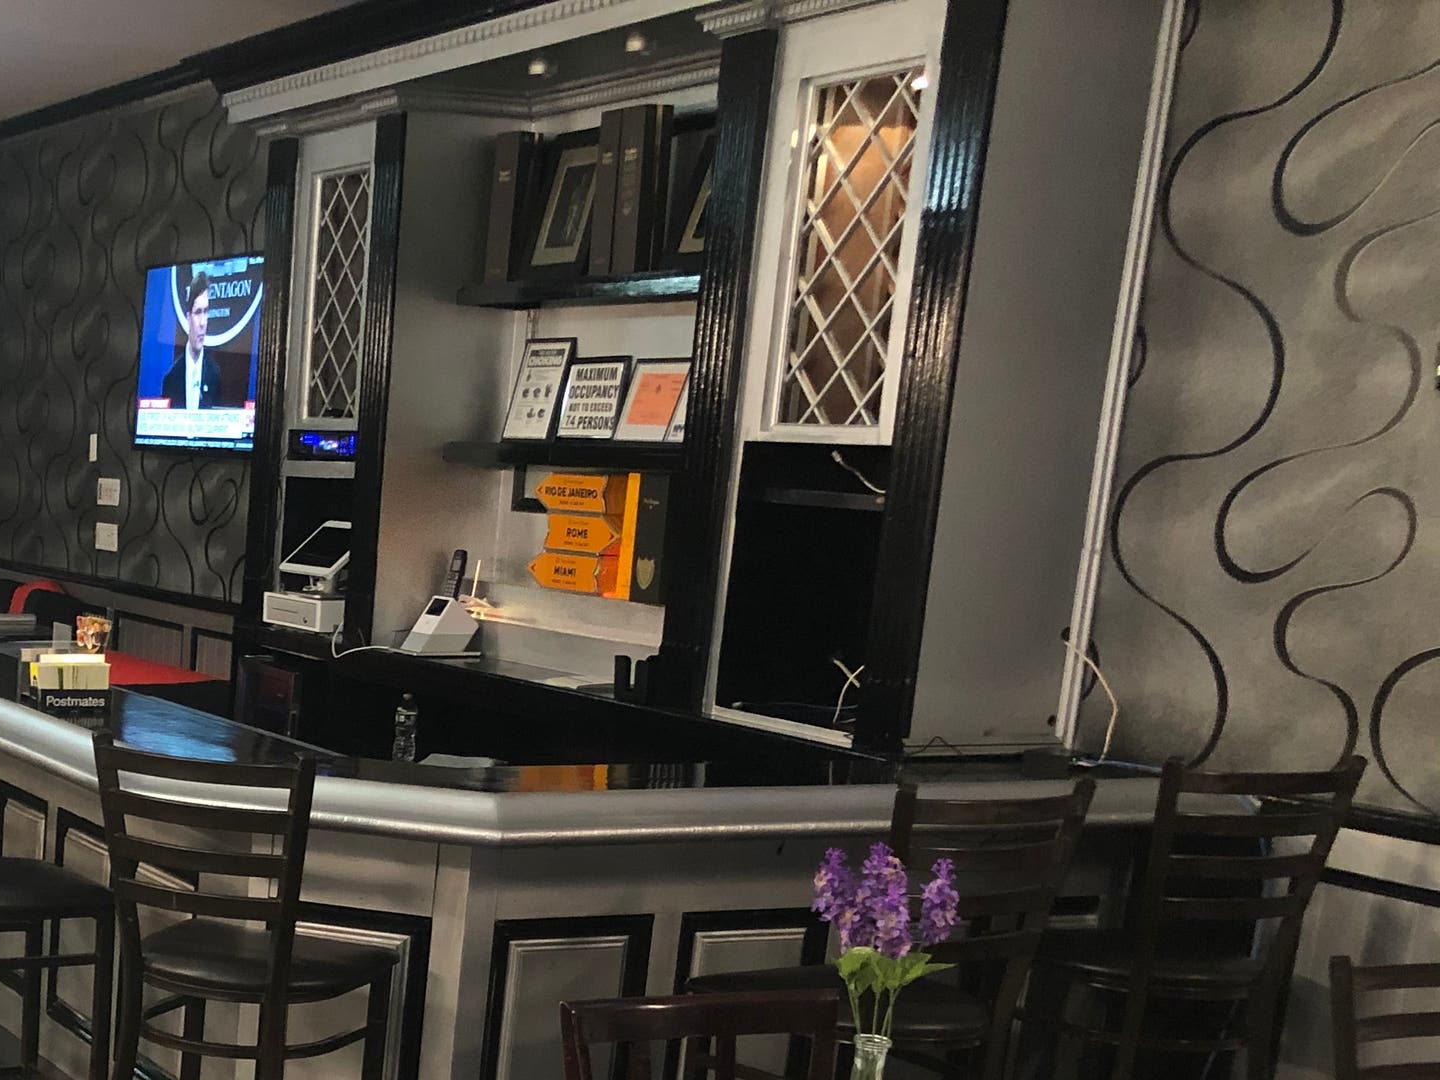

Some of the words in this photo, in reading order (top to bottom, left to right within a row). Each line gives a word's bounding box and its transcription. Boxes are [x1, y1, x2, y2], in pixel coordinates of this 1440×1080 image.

[208, 279, 252, 300] ENTAGON
[576, 367, 618, 381] MAXIMUM
[569, 385, 619, 399] OCCUPANCY
[569, 403, 580, 412] NOT
[581, 402, 589, 412] TO
[589, 402, 613, 412] EXCEED
[565, 415, 576, 426] 74
[576, 415, 615, 431] PERSONS
[544, 486, 557, 497] RIO
[557, 487, 567, 497] DE
[567, 488, 598, 499] JANEIRO
[566, 528, 588, 539] ROME
[554, 566, 576, 576] MIAMI
[46, 695, 105, 707] Postmates
